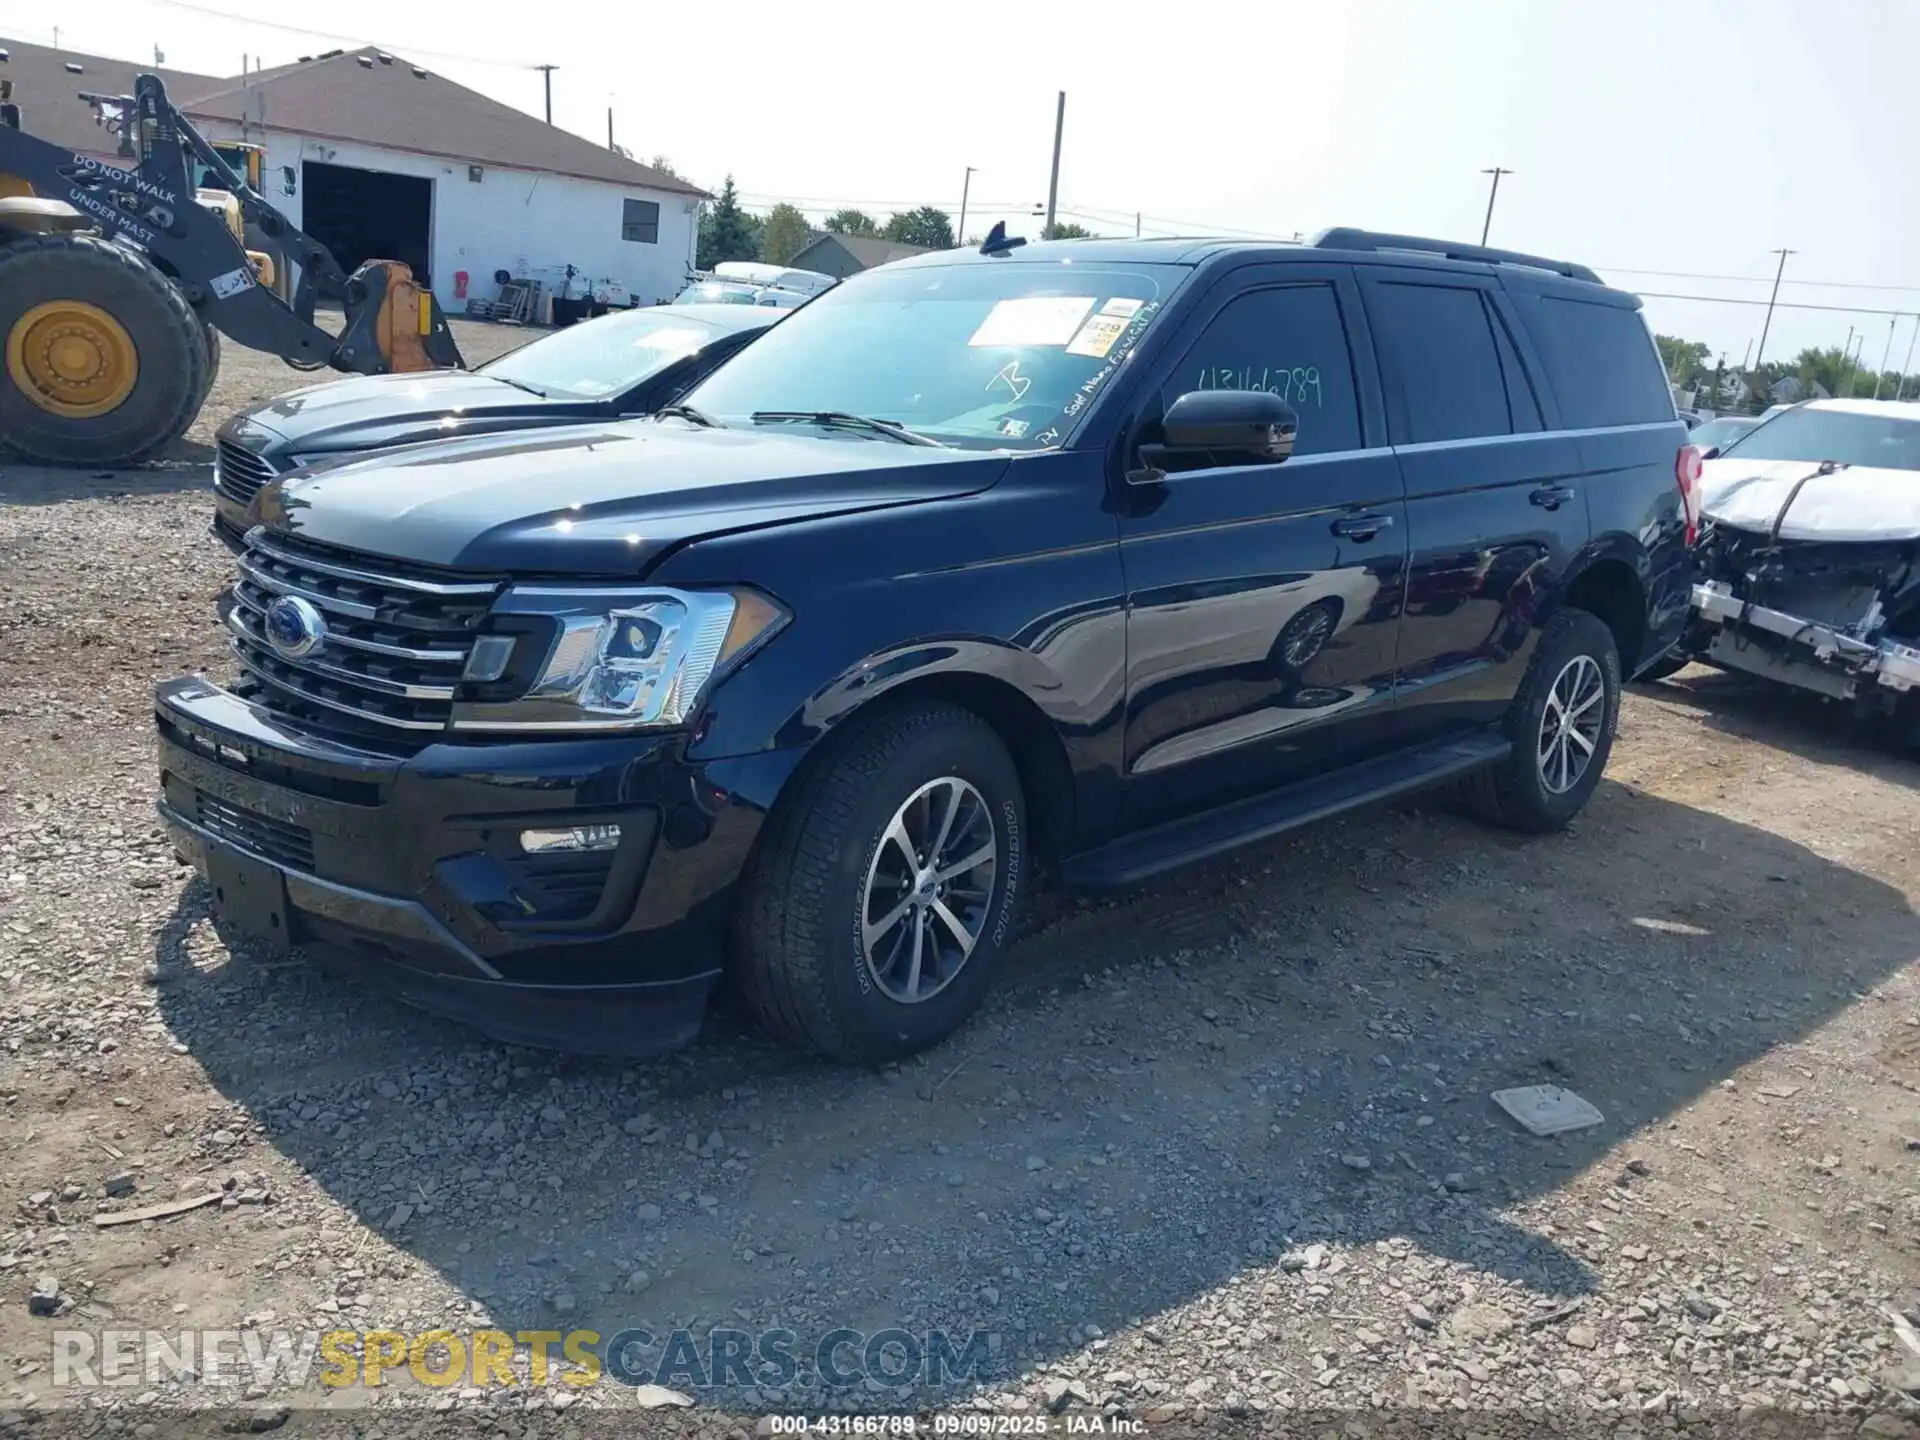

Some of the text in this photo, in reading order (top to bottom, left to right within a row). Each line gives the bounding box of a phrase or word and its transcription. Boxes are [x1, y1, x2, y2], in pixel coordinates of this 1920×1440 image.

[73, 153, 176, 204] DO NOT WALK
[69, 187, 156, 242] UNDER MAST
